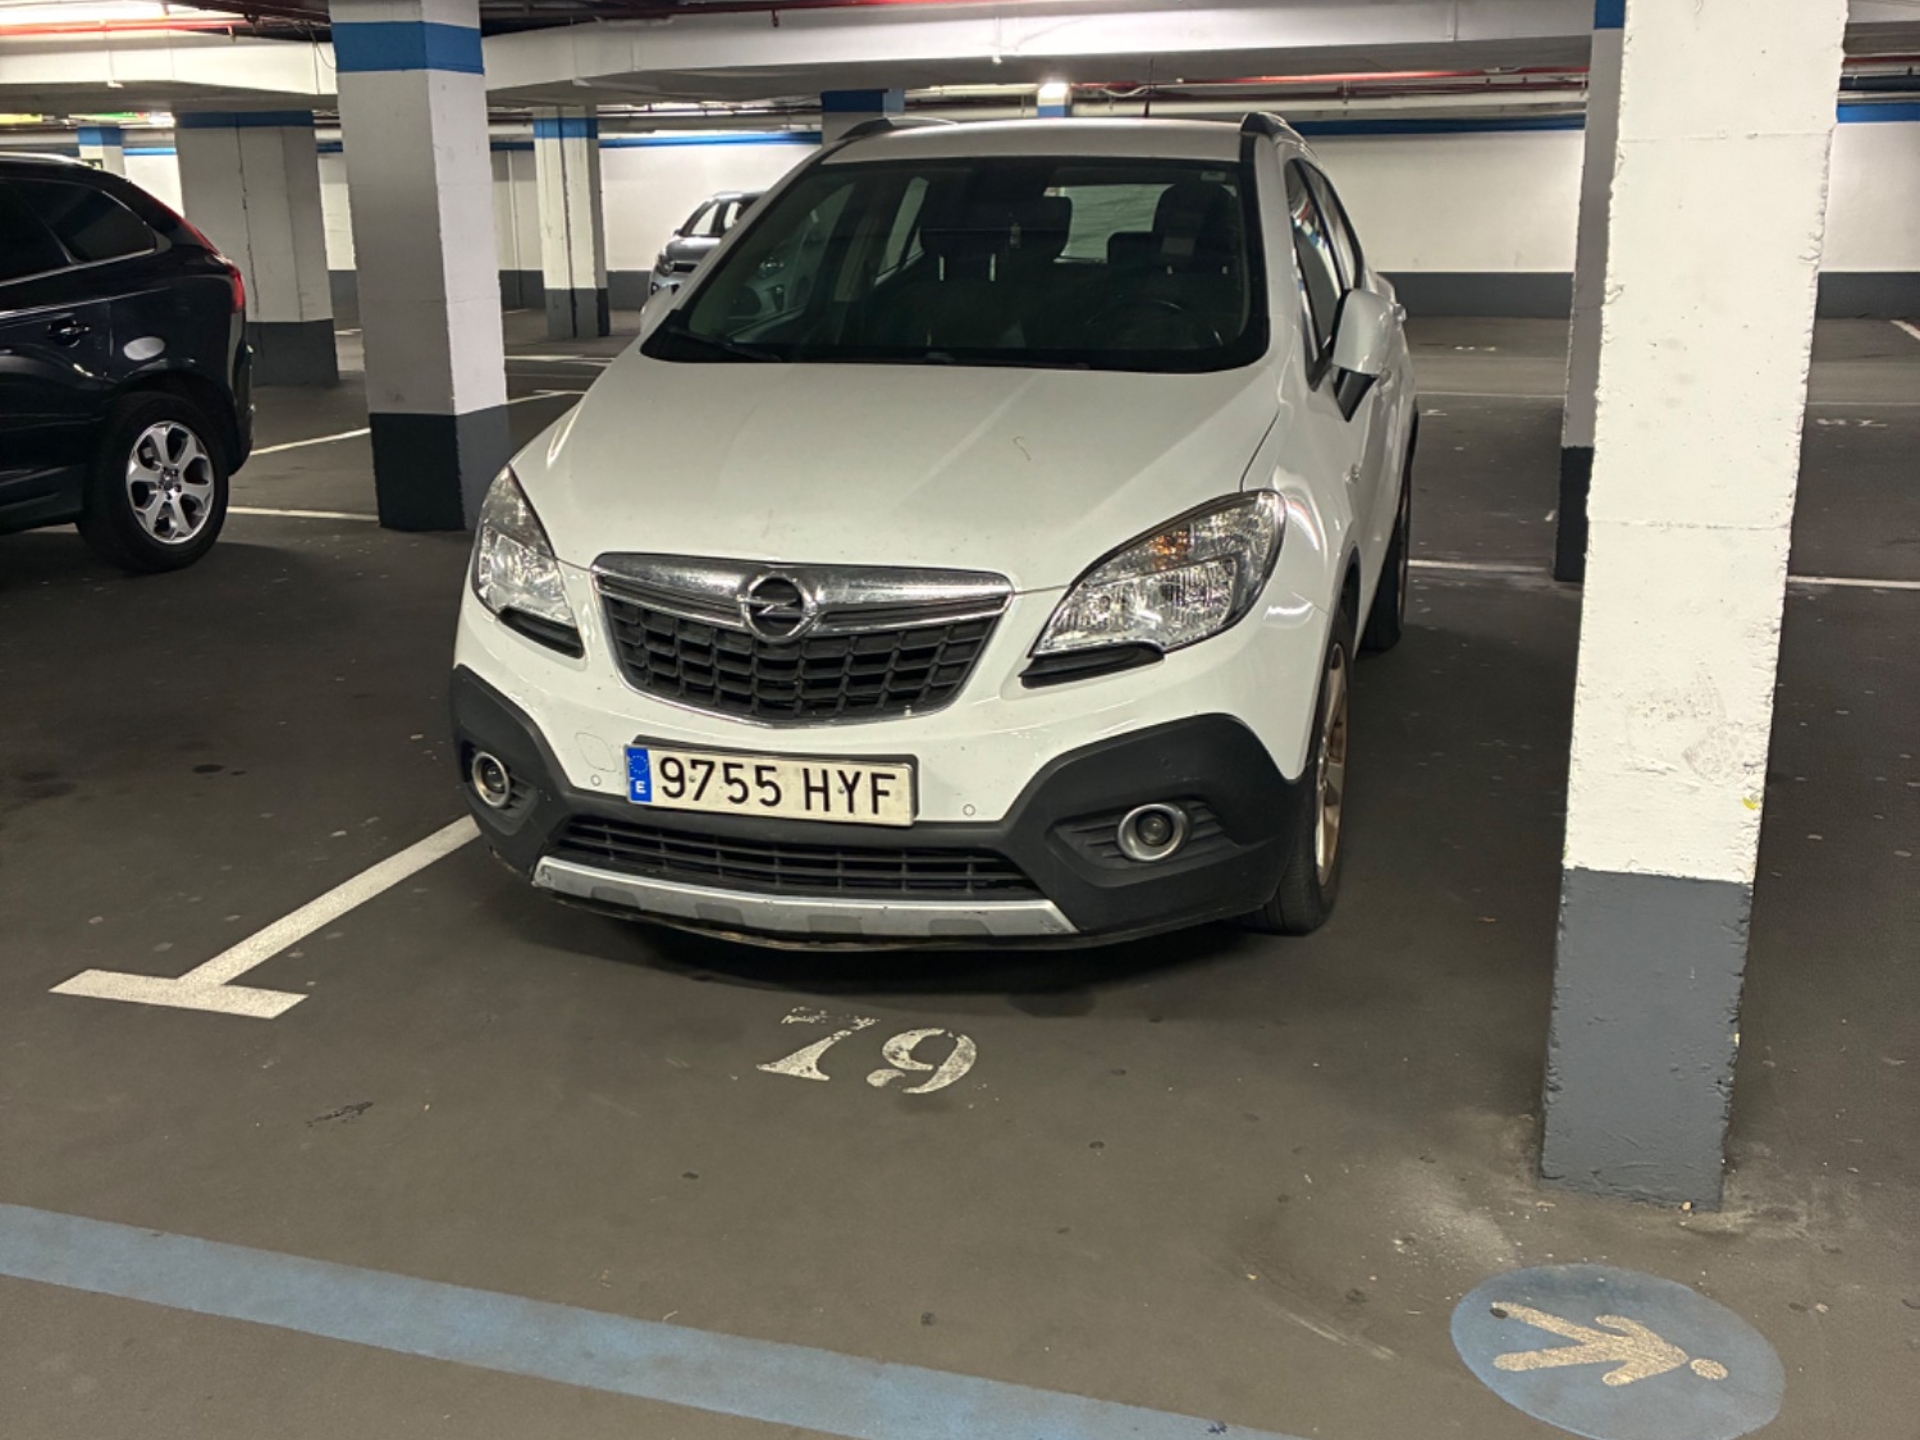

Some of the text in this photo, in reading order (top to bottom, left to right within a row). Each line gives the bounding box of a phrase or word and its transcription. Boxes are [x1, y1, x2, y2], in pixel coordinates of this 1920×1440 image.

[635, 781, 646, 793] E
[659, 756, 896, 814] 9755 HYF
[756, 1007, 977, 1094] 79
